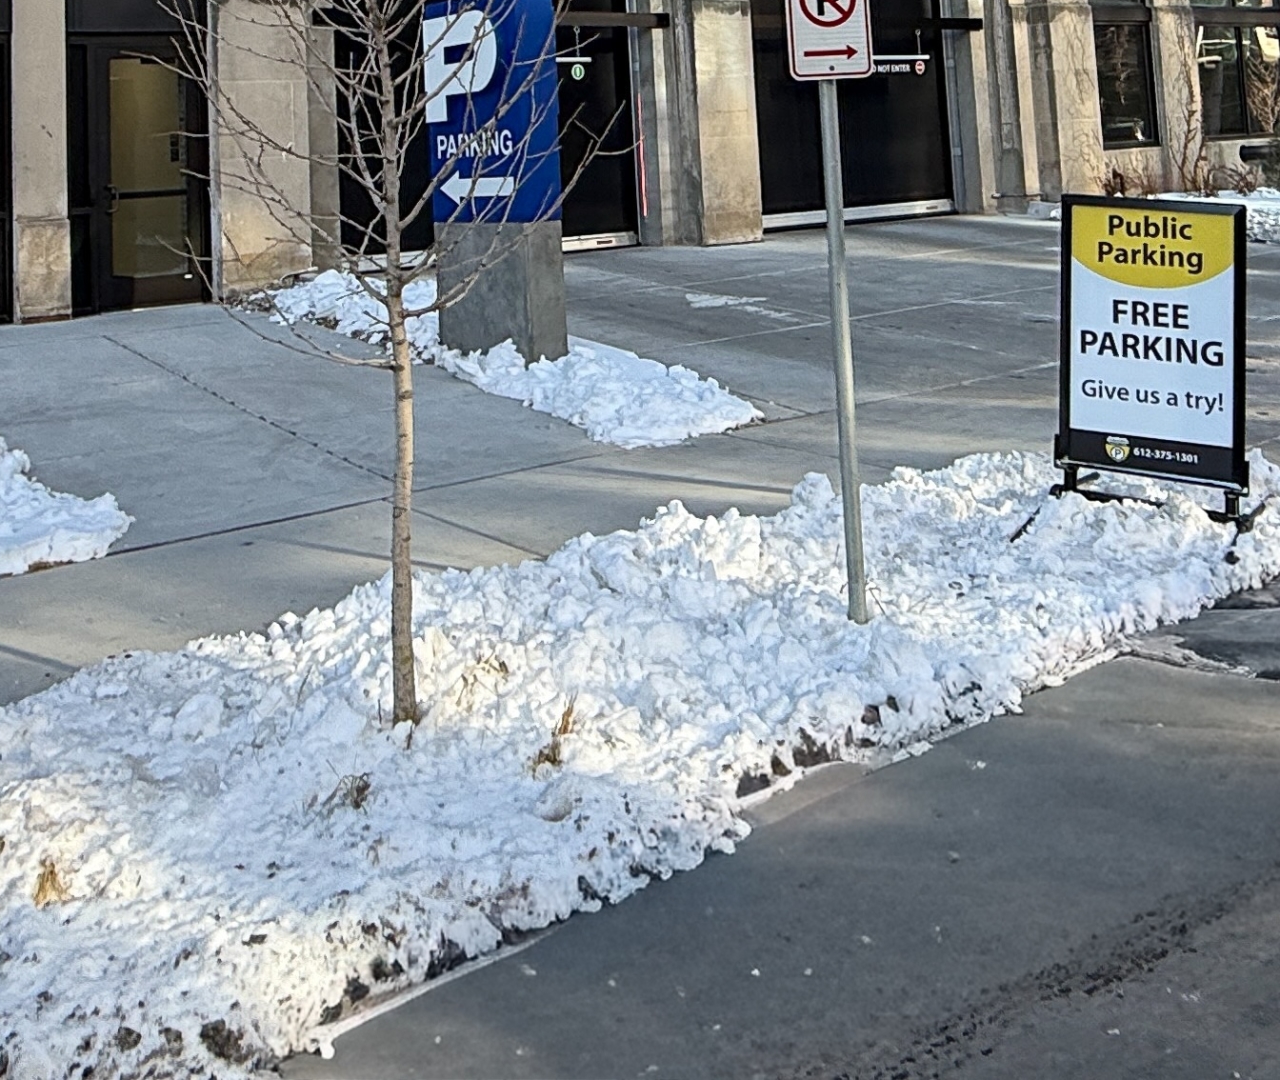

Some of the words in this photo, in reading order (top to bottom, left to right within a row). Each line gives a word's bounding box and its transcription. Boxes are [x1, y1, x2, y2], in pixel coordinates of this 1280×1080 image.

[422, 9, 498, 124] P
[1108, 214, 1193, 240] Public
[1097, 241, 1203, 275] Parking
[1112, 299, 1190, 330] FREE
[1080, 330, 1224, 366] PARKING
[1081, 379, 1130, 401] Give
[1136, 388, 1160, 404] us
[1166, 392, 1178, 406] a
[1186, 390, 1224, 415] try!
[1133, 446, 1199, 464] 612-375-1301
